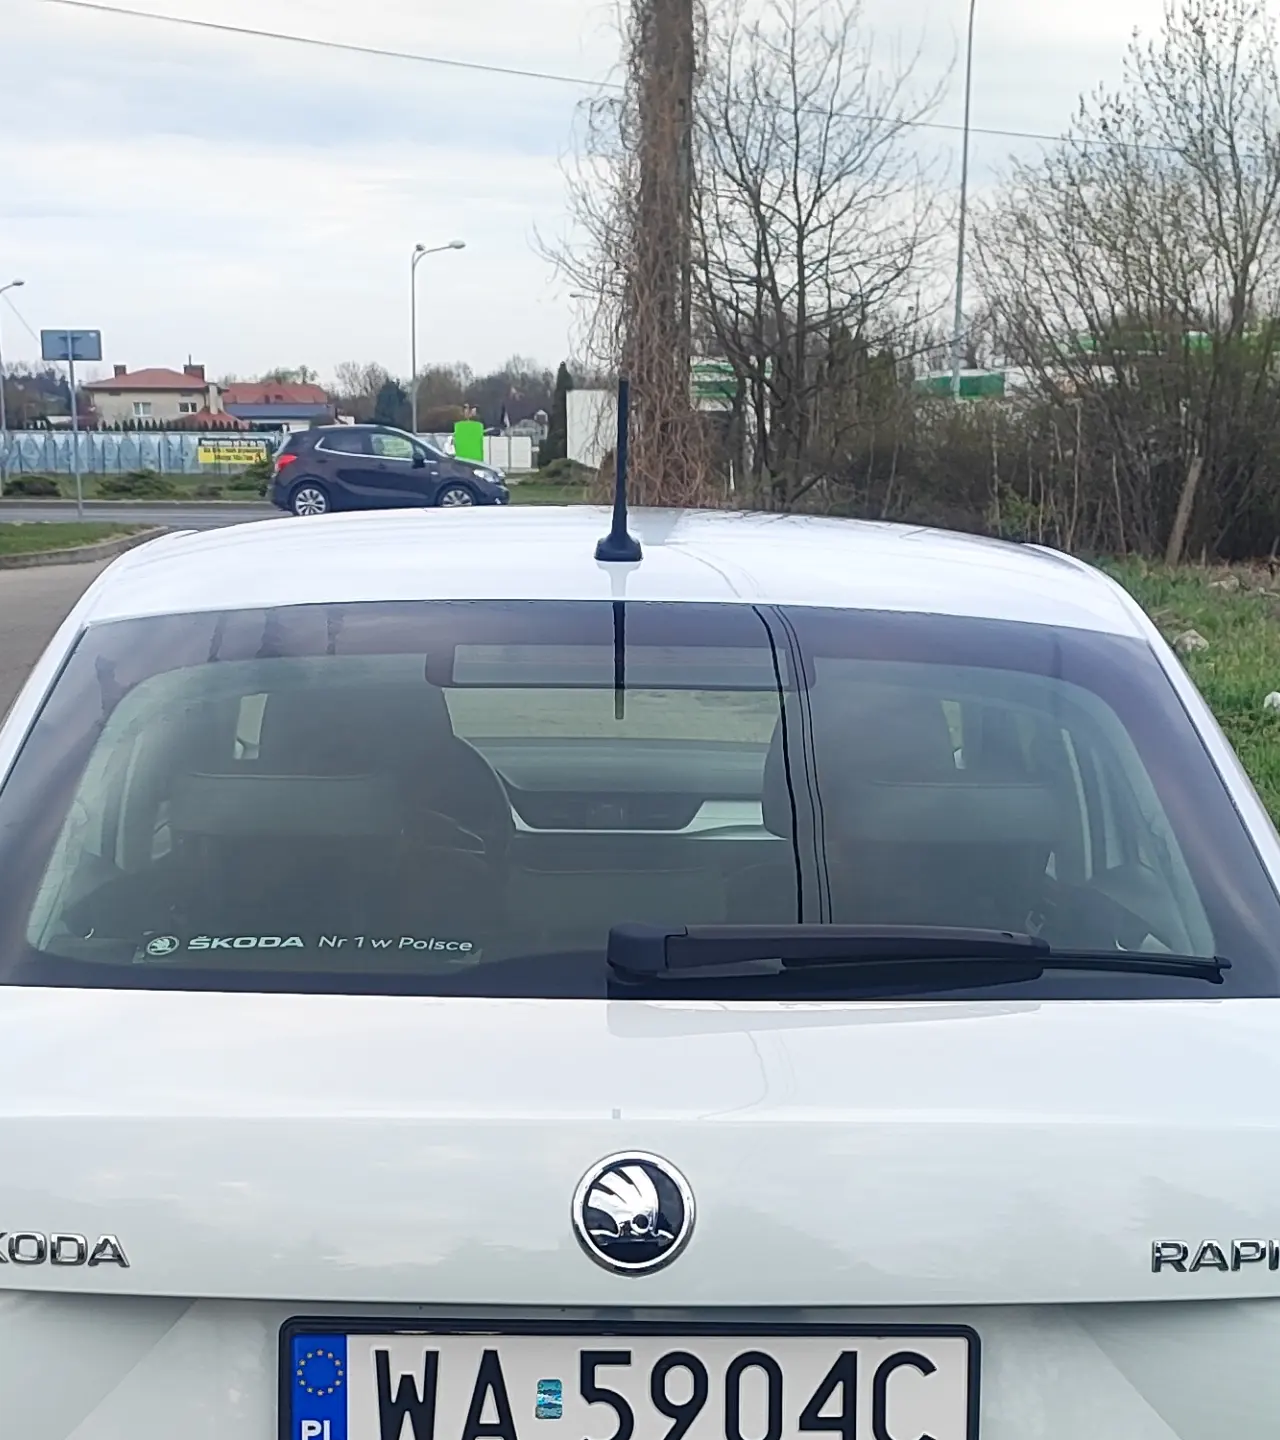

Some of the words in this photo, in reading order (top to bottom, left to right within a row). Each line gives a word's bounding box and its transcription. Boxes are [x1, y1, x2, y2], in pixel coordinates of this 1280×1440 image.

[187, 935, 305, 949] ŠKODA
[318, 936, 348, 949] Nr
[354, 937, 363, 948] 1
[371, 939, 392, 948] w
[398, 937, 473, 951] Polsce
